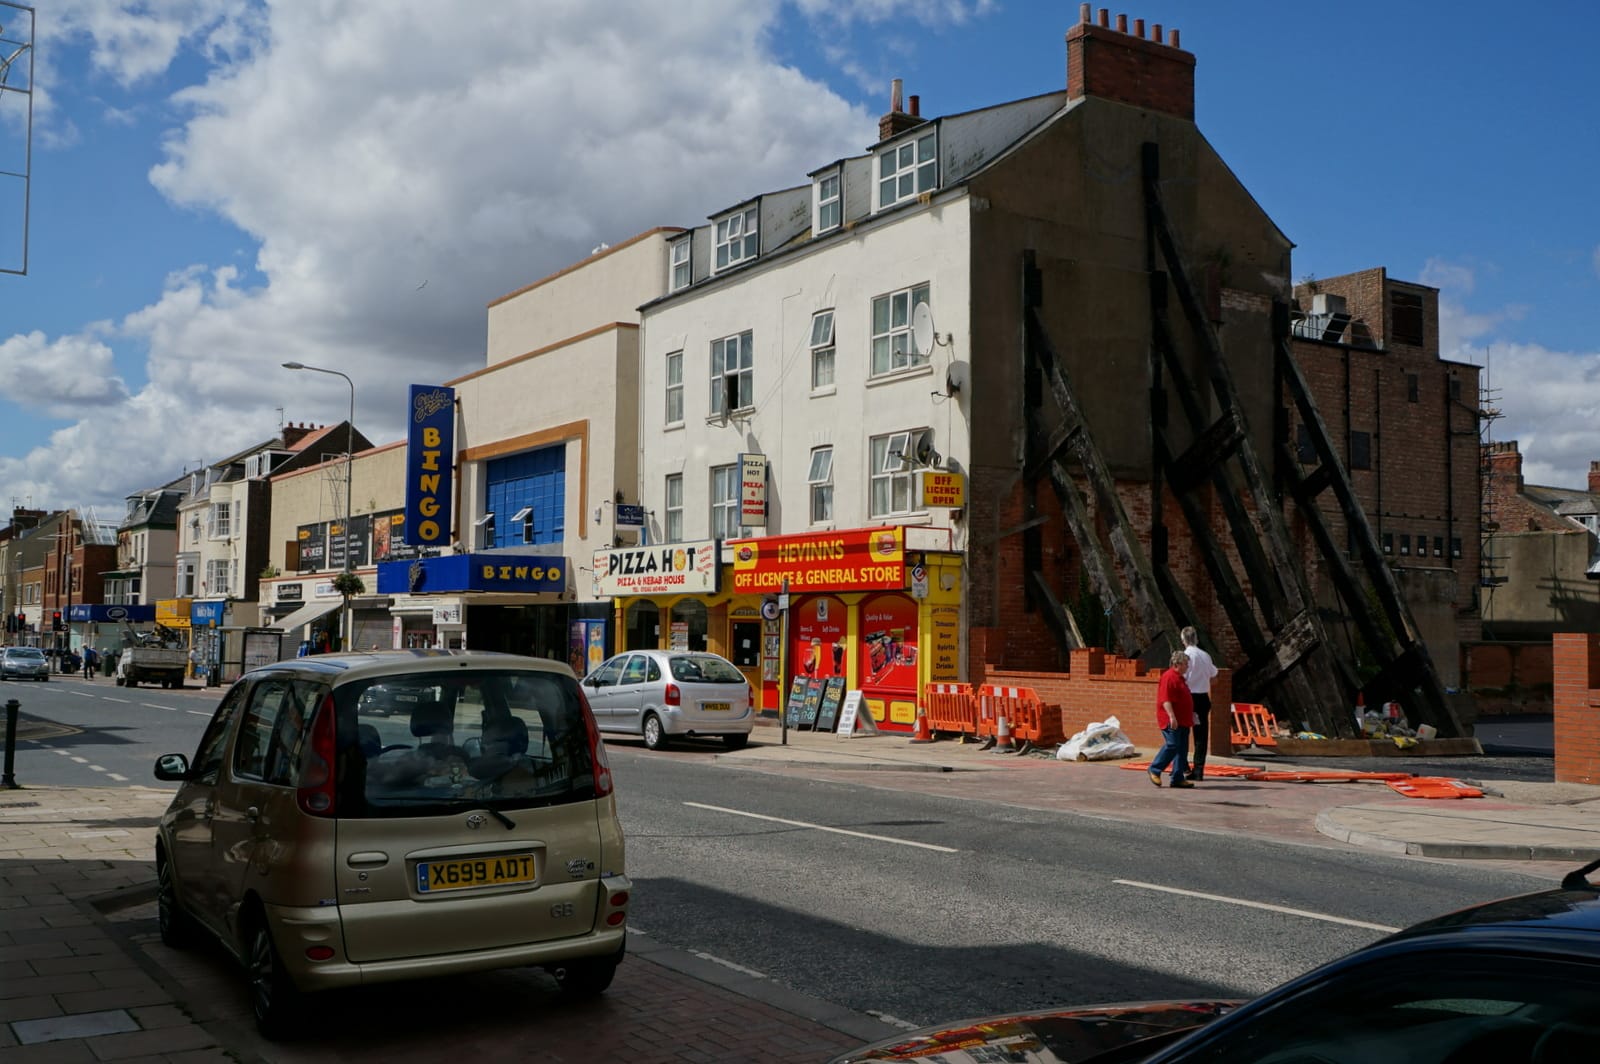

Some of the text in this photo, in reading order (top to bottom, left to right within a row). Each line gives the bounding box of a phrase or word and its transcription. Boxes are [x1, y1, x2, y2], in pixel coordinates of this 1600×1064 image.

[418, 427, 441, 541] BINGO
[934, 476, 952, 485] OFF
[926, 486, 960, 494] LICENCE
[932, 496, 954, 504] OPEN
[778, 539, 844, 564] HEVINNS
[609, 551, 658, 576] PIZZA
[483, 565, 561, 581] BINGO
[617, 577, 636, 587] PIZZA
[642, 576, 662, 586] KEBAB
[664, 574, 685, 585] HOUSE
[735, 566, 900, 587] OFF LICENCE & GENERAL STORE
[433, 858, 530, 885] X699 ADT
